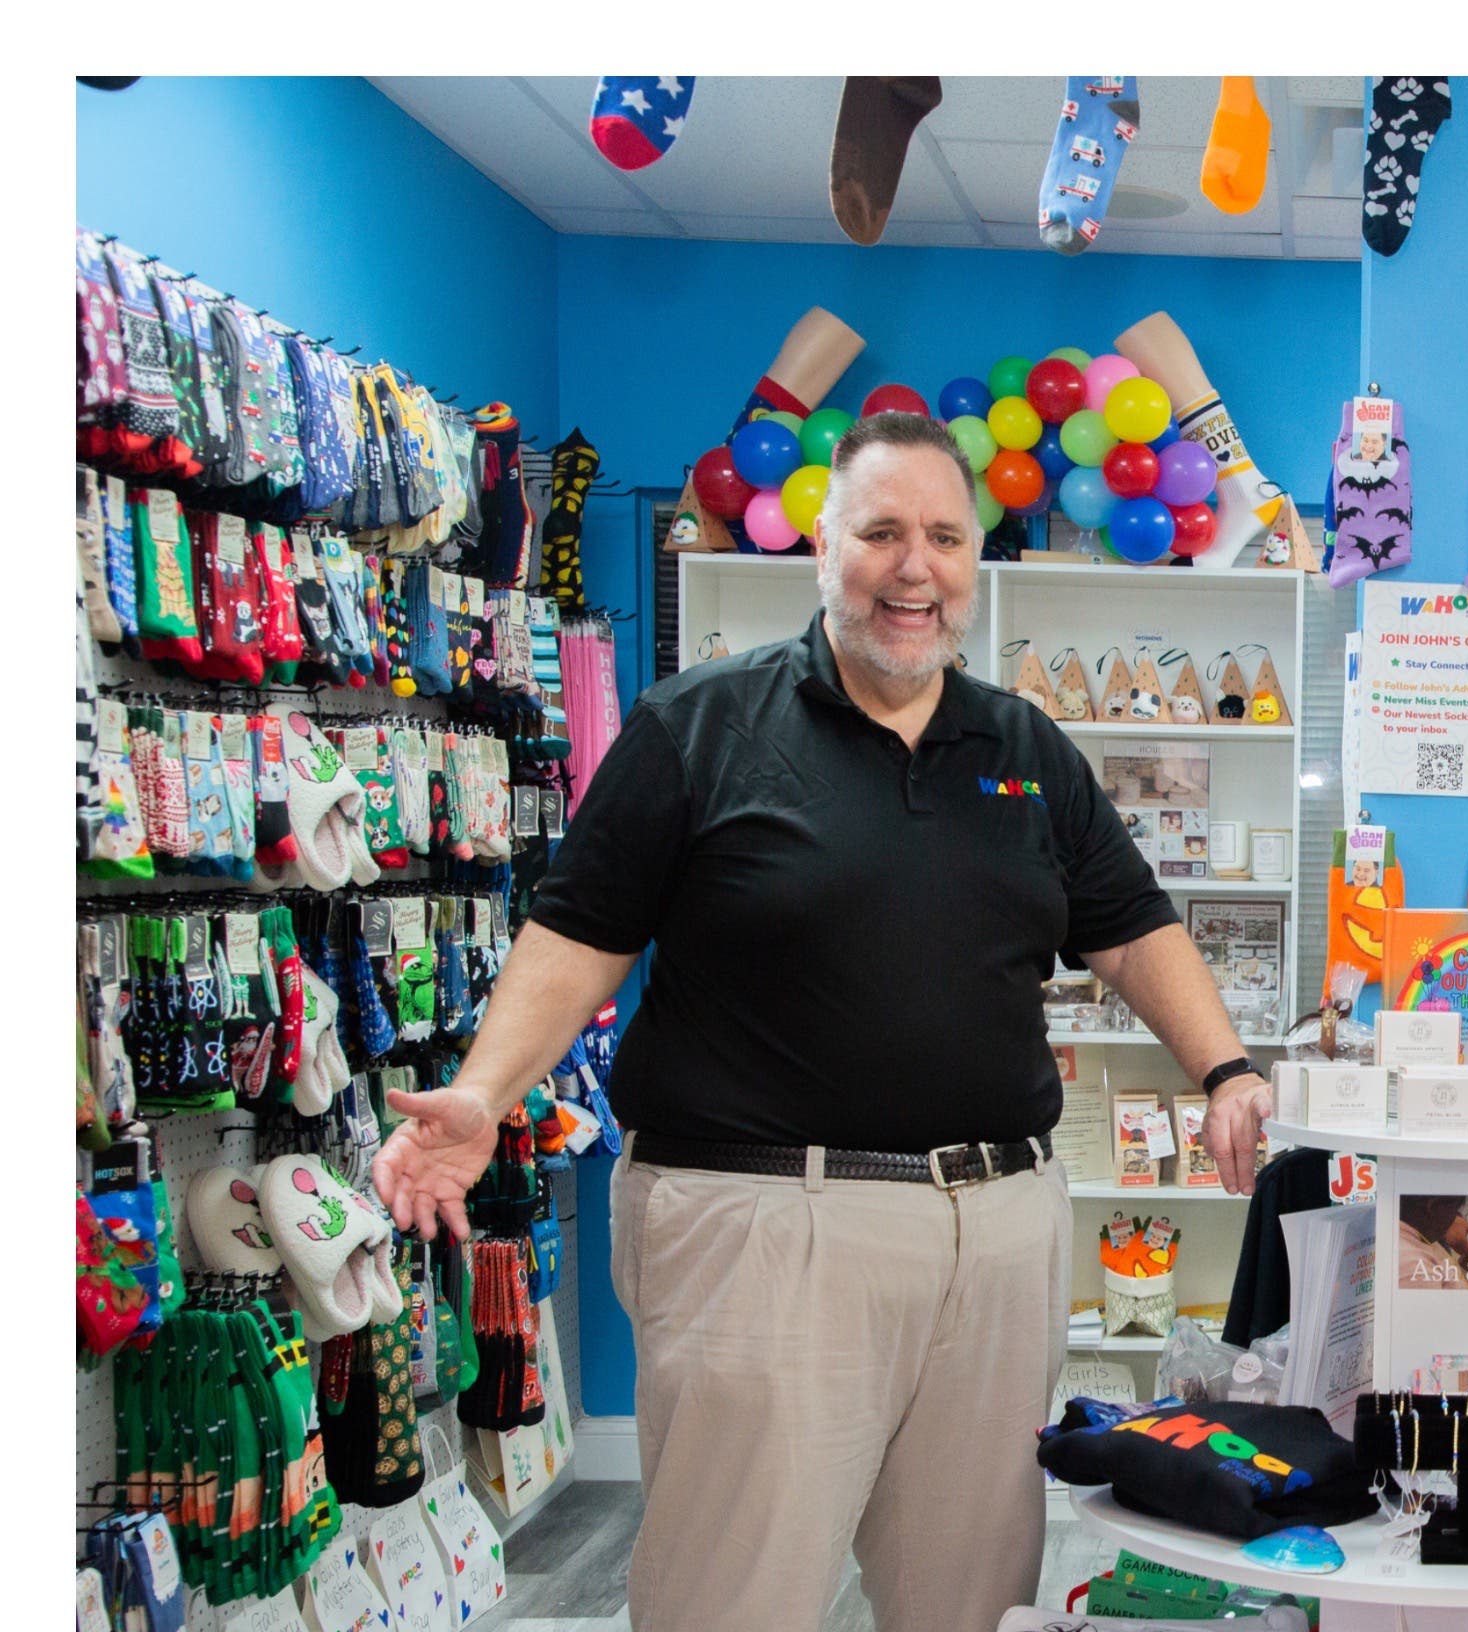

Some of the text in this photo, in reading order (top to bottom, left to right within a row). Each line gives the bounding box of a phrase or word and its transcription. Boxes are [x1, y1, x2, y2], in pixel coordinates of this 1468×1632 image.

[1380, 634, 1410, 645] JOIN
[1413, 635, 1461, 646] JOHN'S
[1405, 659, 1427, 670] Stay
[1384, 682, 1418, 691] Follow
[1420, 683, 1450, 692] John's
[1384, 695, 1413, 705] Never
[1415, 696, 1437, 706] Miss
[1384, 709, 1403, 719] Our
[1405, 710, 1441, 720] Newest
[1384, 724, 1448, 735] to your inbox
[977, 776, 1043, 796] WAHOO
[95, 1166, 134, 1180] HOTSOX
[1357, 1251, 1375, 1268] COLO
[1410, 1258, 1459, 1282] Ash
[1067, 1364, 1109, 1381] Girls
[1055, 1382, 1132, 1401] Mystery
[1122, 1558, 1207, 1583] GAMER SOCKS
